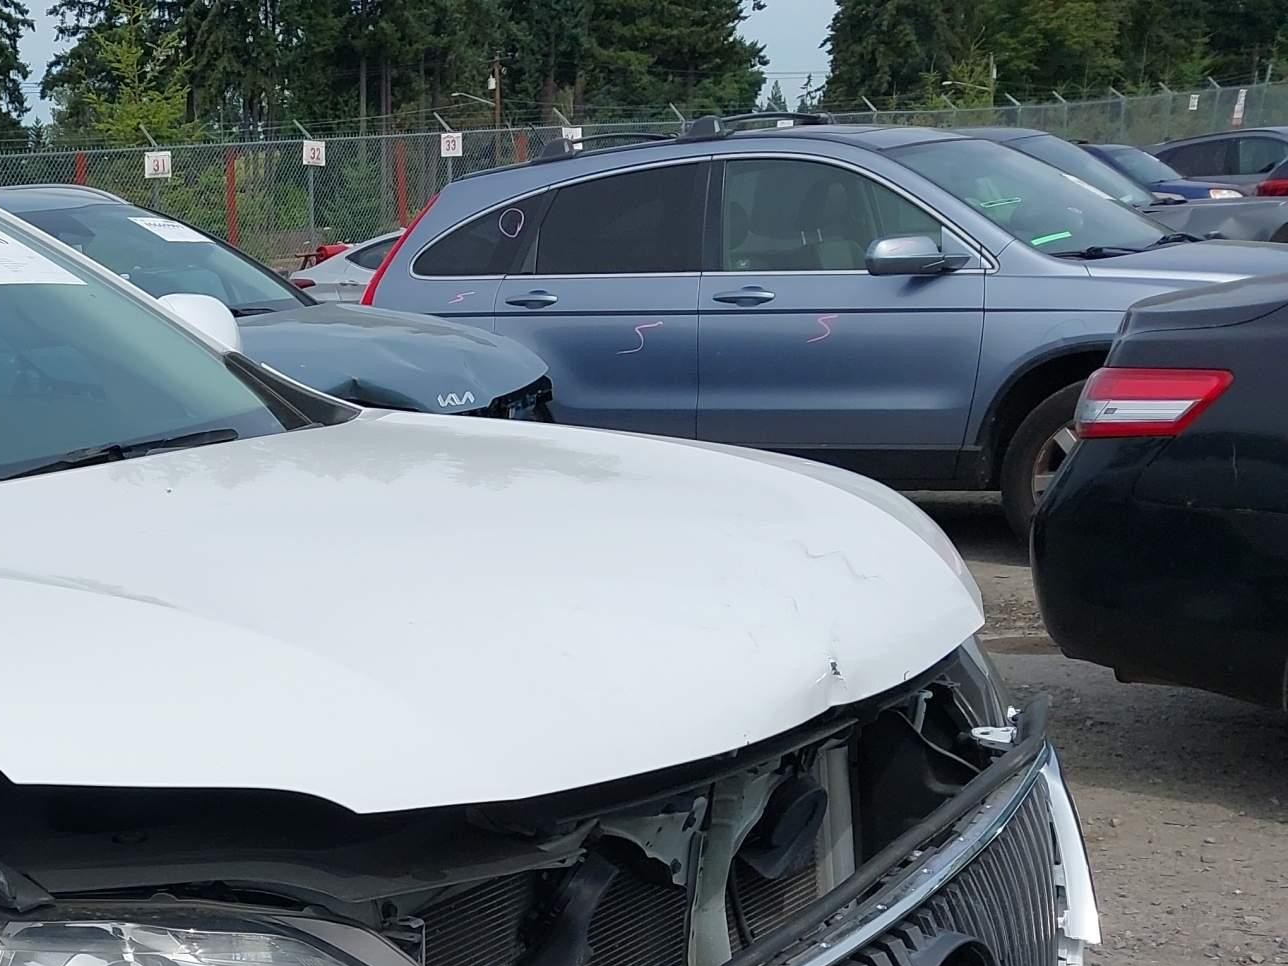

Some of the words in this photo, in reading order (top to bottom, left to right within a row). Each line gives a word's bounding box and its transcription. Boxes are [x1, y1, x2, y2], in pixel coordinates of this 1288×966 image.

[445, 139, 457, 152] 33
[310, 147, 321, 161] 32
[152, 159, 167, 172] 31
